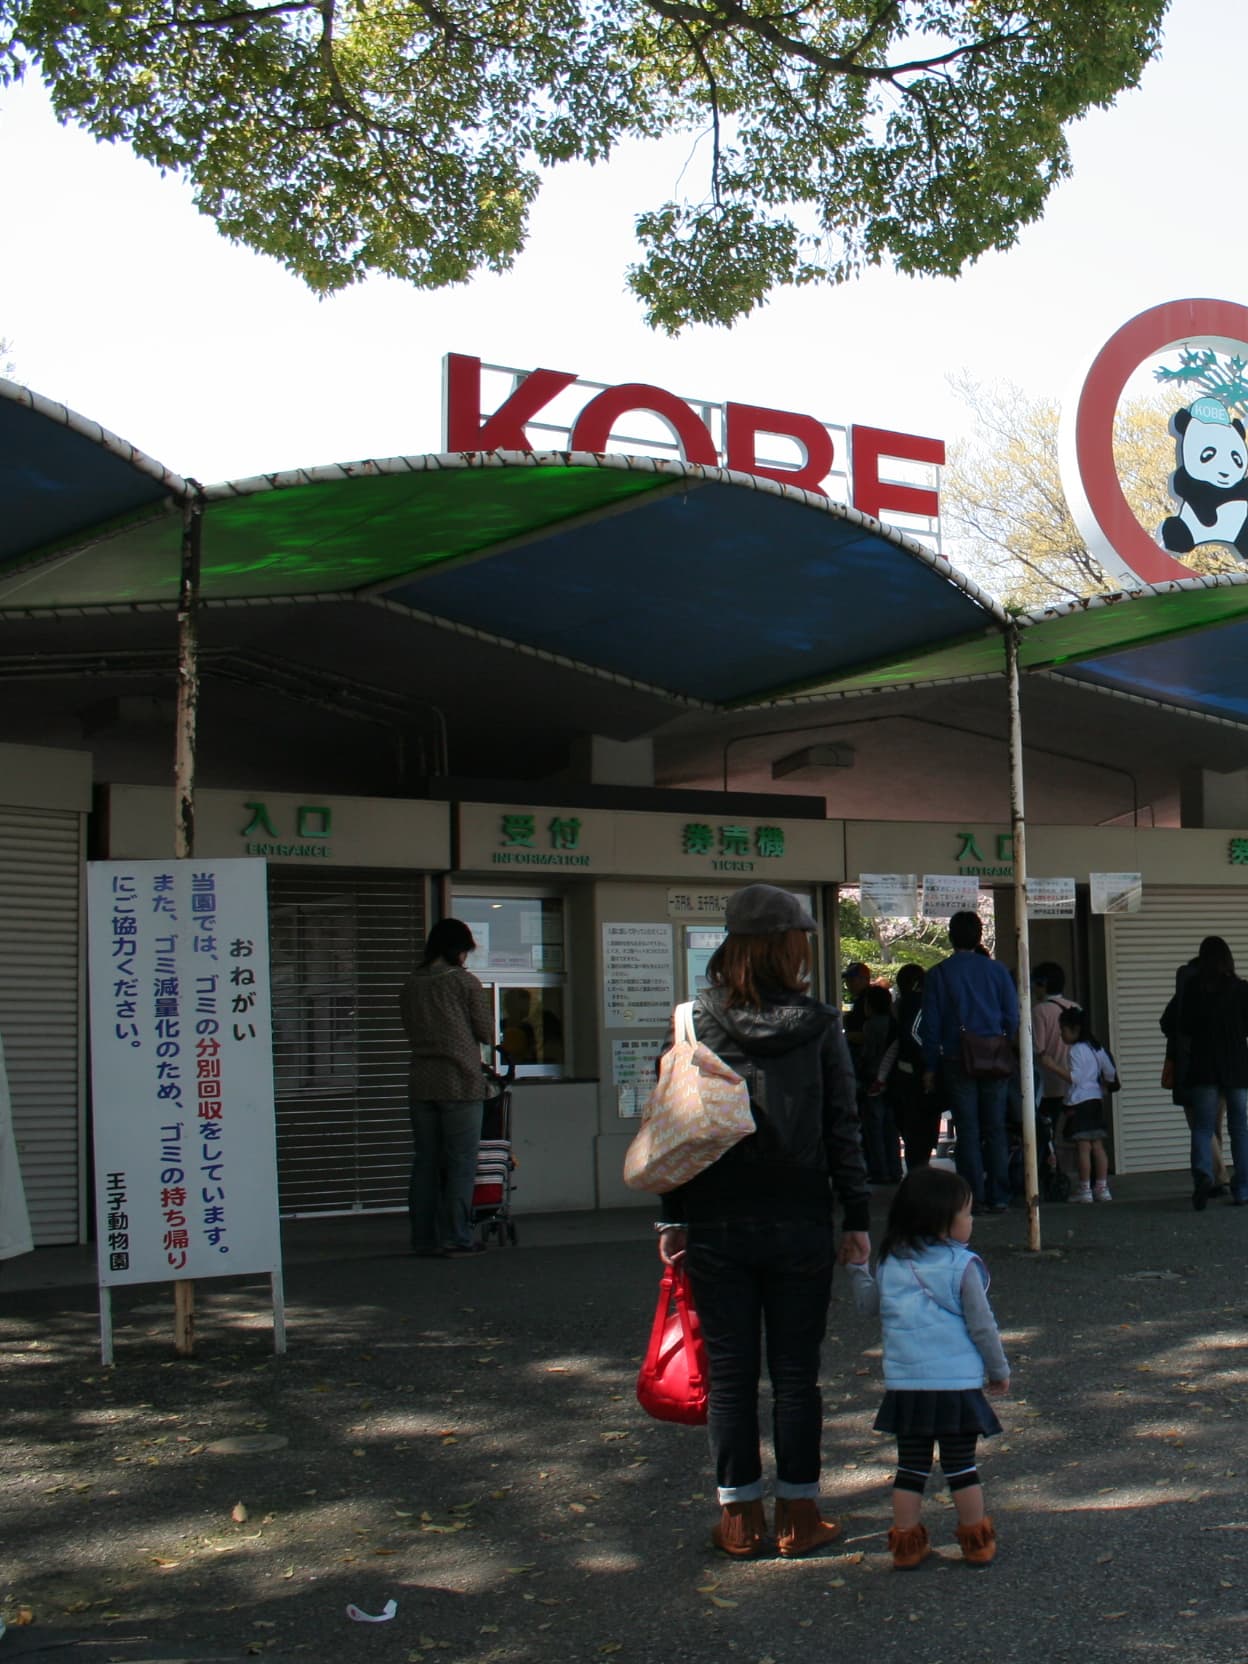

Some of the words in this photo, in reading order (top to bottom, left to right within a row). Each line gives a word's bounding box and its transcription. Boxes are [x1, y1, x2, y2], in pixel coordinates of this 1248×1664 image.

[1195, 405, 1225, 420] KOBE
[446, 352, 946, 540] KOBE
[241, 802, 332, 838] 入口
[500, 814, 583, 850] 受付
[246, 843, 332, 857] ENTRANCE
[682, 823, 785, 858] 券売機
[955, 832, 1014, 861] 入口
[492, 852, 590, 867] INFORMATION
[711, 859, 756, 872] TICKET
[112, 875, 141, 1048] にご協力ください。
[229, 937, 257, 1042] おねがい
[152, 873, 190, 1270] また、ゴミ減量化のため、ゴミの持ち帰り
[191, 872, 230, 1254] 当園では、ゴミの分別回収をしています。
[105, 1172, 130, 1272] 王子動物園
